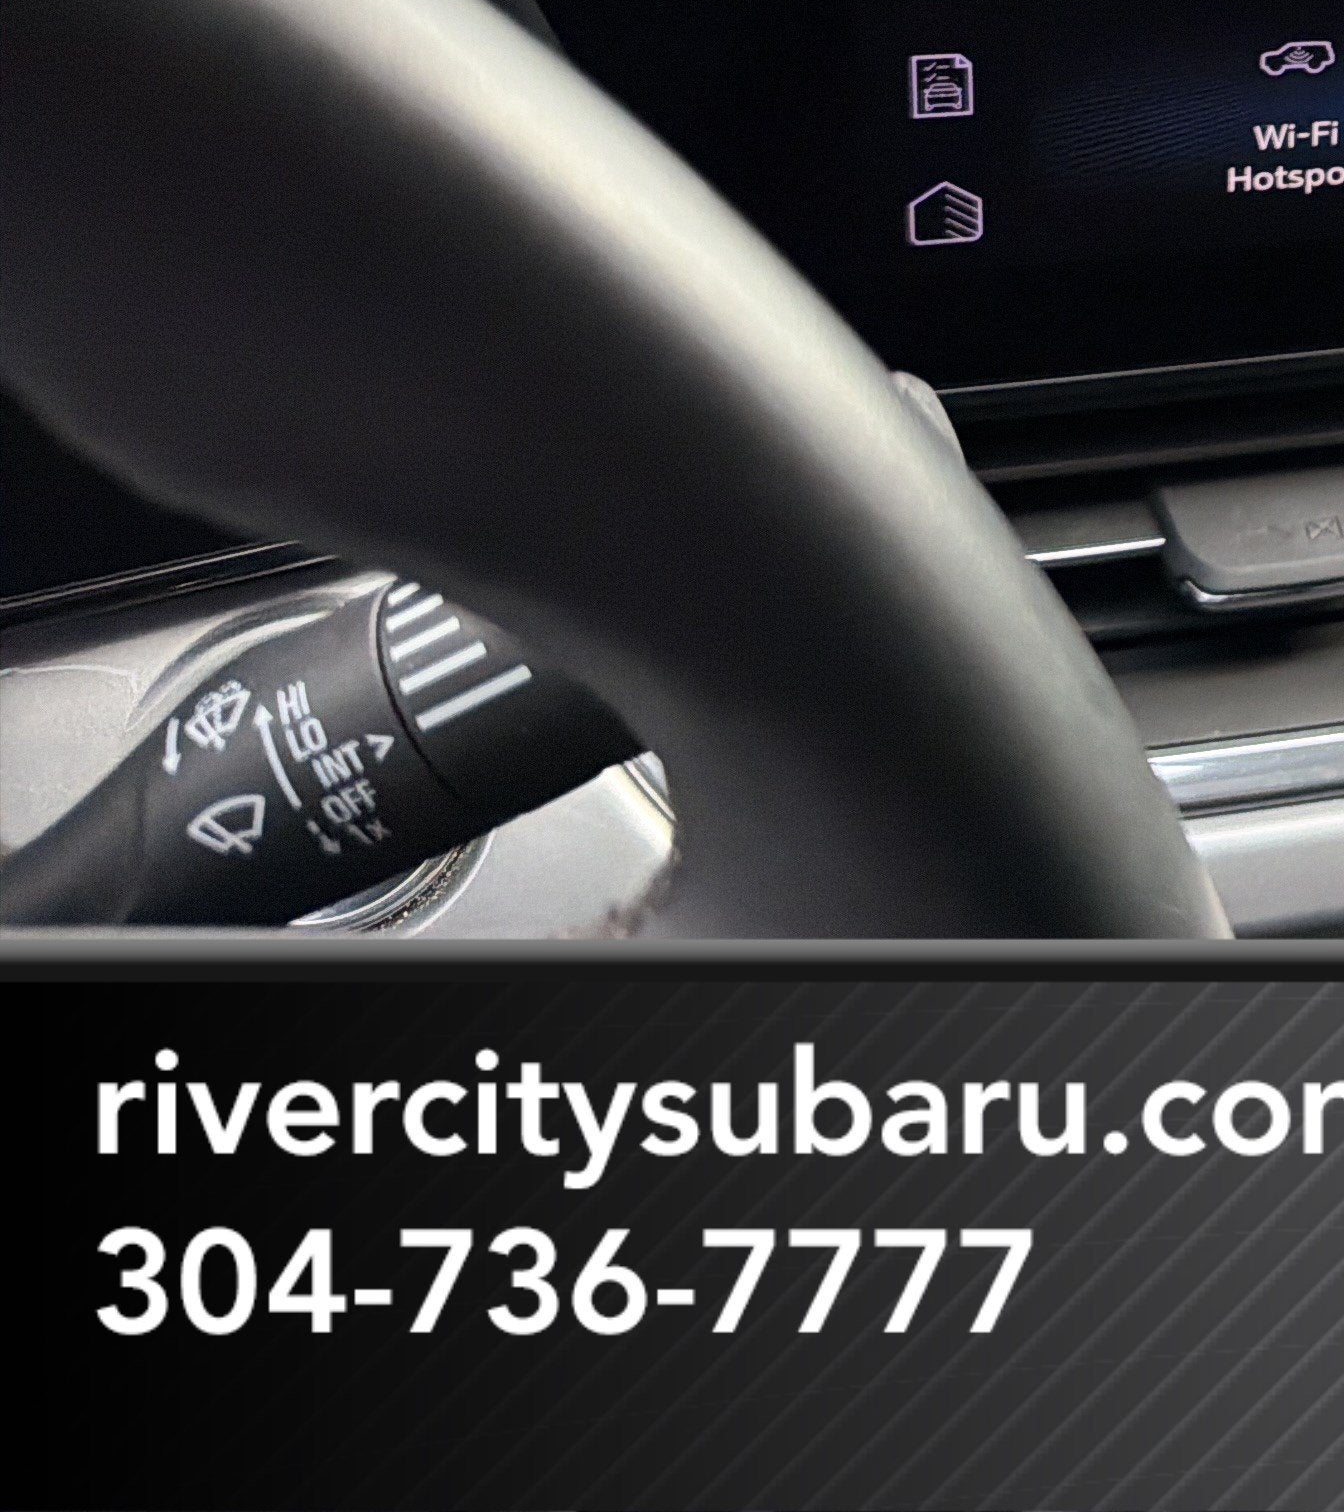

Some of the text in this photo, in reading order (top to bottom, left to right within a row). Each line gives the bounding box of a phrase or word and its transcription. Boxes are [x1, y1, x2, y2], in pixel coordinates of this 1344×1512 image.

[1252, 120, 1340, 151] Wi-Fi
[276, 680, 310, 726] HI
[285, 717, 328, 762] LO
[311, 739, 365, 789] INT
[321, 778, 377, 824] OFF
